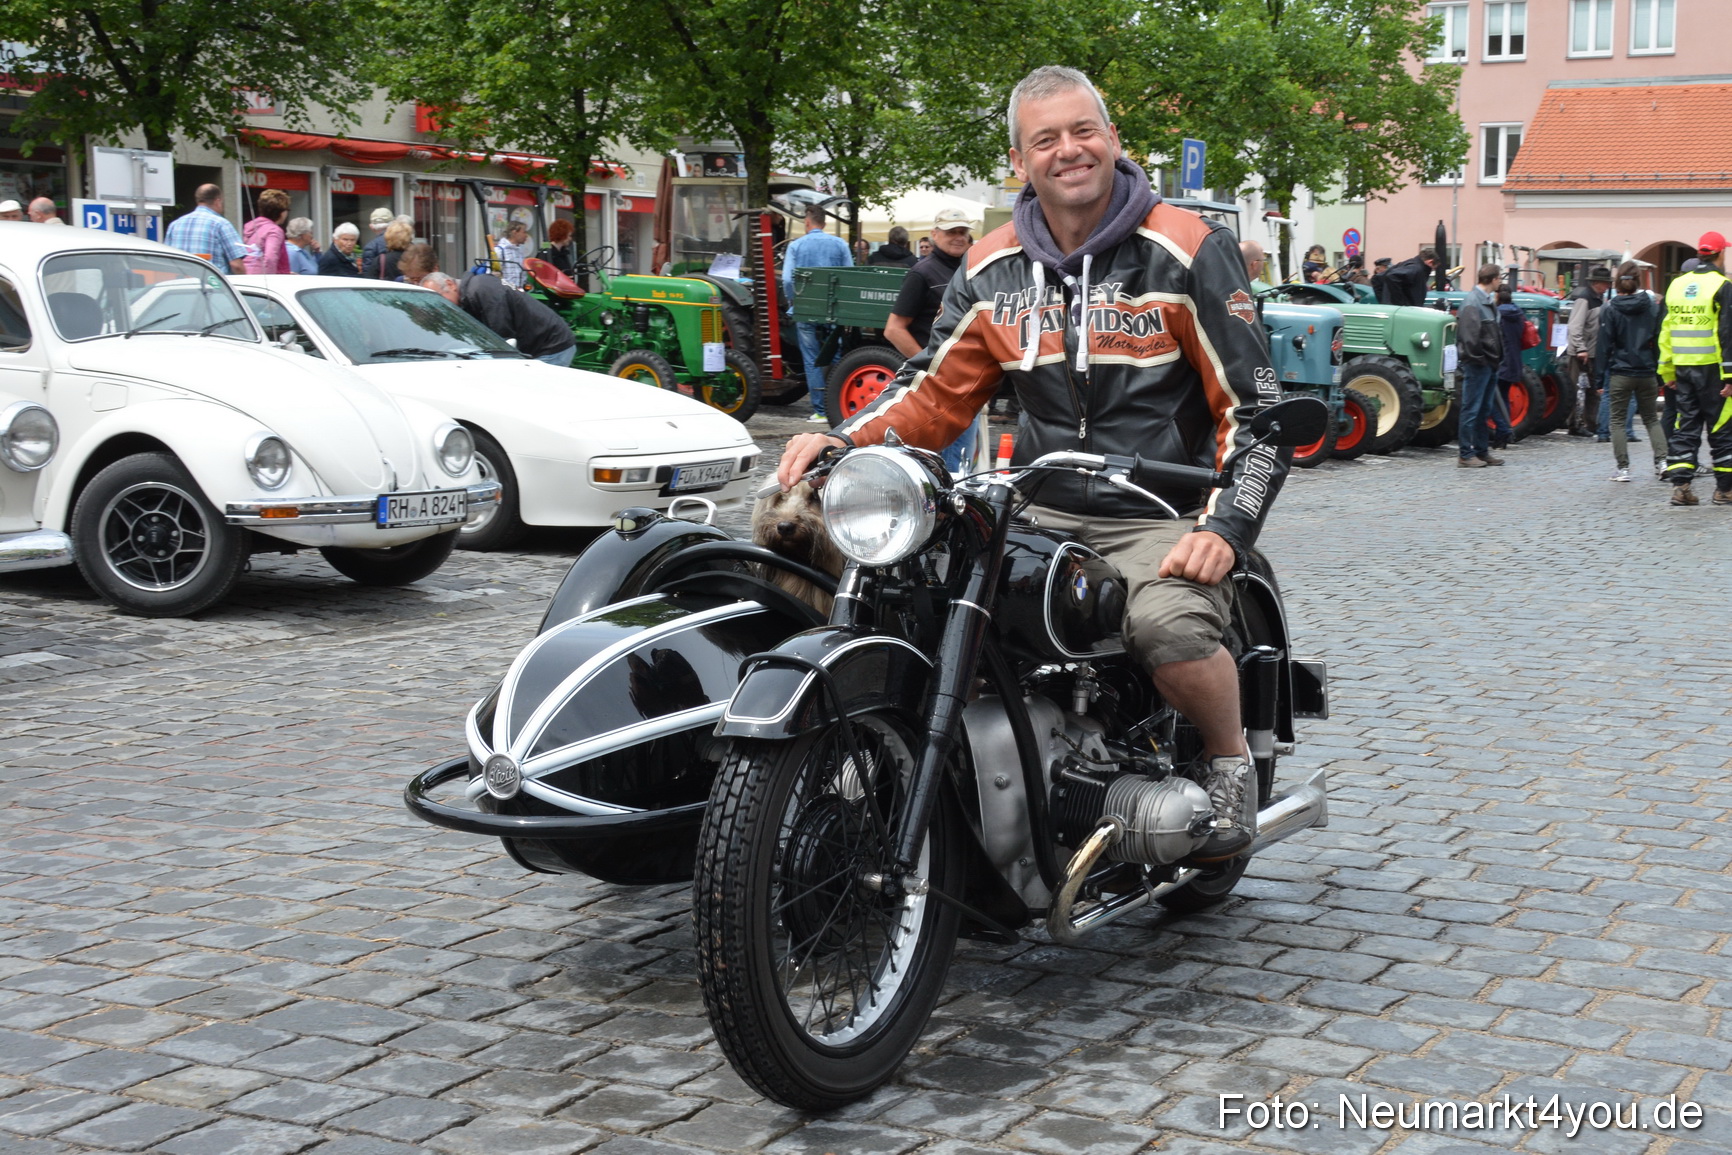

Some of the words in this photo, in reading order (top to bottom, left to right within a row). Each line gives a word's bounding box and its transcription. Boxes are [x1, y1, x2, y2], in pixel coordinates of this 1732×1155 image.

[1186, 146, 1201, 183] P
[117, 213, 154, 229] HIR
[1670, 305, 1706, 314] FOLLOW
[1680, 316, 1693, 325] ME
[1096, 335, 1167, 356] Motorcycles
[696, 464, 731, 482] X944H
[388, 498, 409, 519] RH
[419, 497, 428, 518] A
[432, 493, 465, 516] 824H
